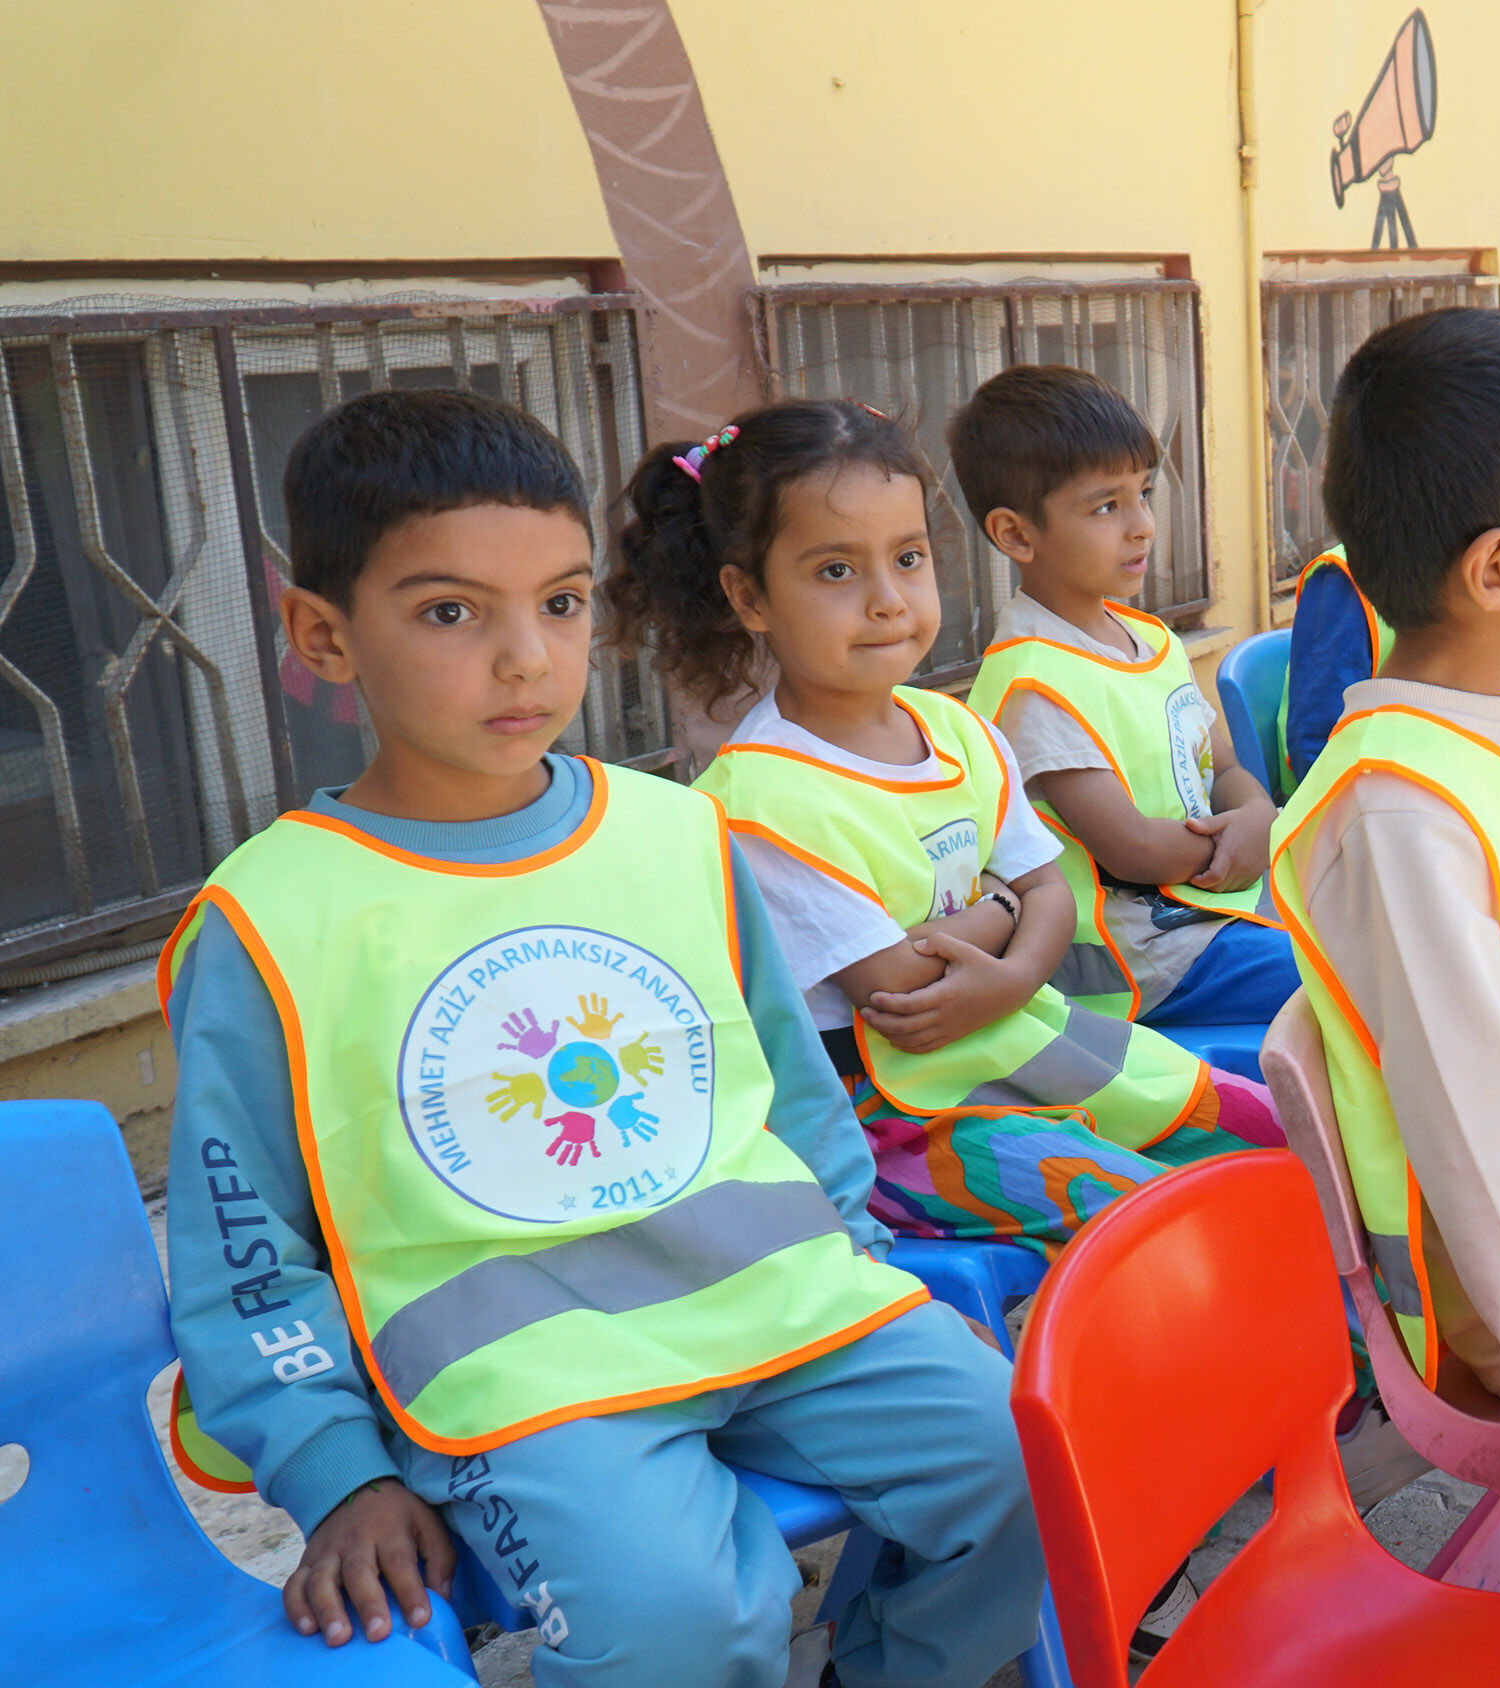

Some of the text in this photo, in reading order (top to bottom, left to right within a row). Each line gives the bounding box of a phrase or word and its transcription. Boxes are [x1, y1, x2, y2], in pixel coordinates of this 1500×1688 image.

[417, 938, 709, 1175] MEHMET AZİZ PARMAKSIZ ANAOKULU
[590, 1168, 665, 1210] 2011
[251, 1319, 335, 1386] BE
